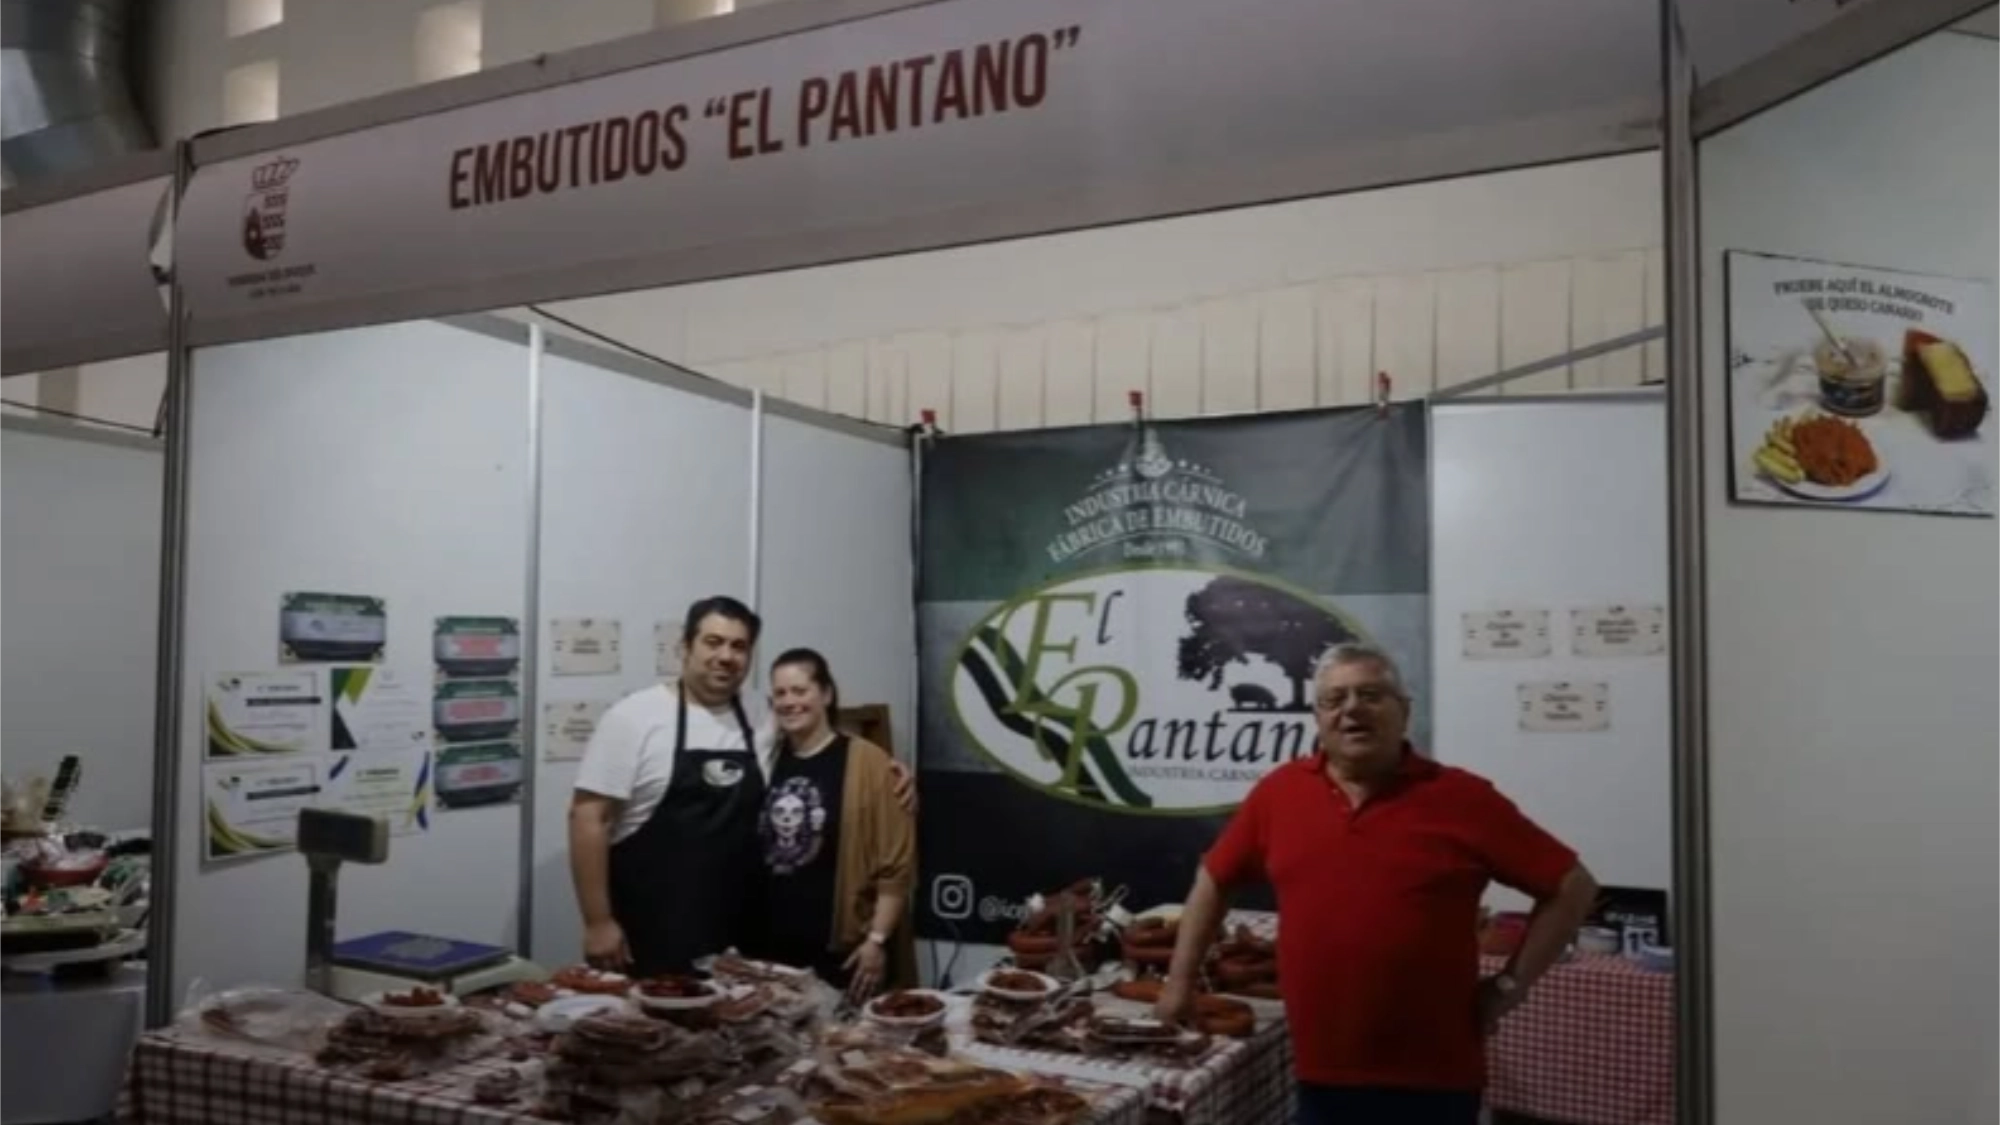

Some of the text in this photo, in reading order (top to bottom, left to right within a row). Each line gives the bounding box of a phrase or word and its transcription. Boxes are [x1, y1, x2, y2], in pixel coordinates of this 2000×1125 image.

[450, 104, 689, 209] EMBUTIDOS
[1860, 279, 1875, 295] EL
[1064, 481, 1160, 525] INDUSTRIA
[1046, 506, 1269, 563] FÁBRICA DE EMBUTIDOS
[1034, 665, 1324, 792] Pantan
